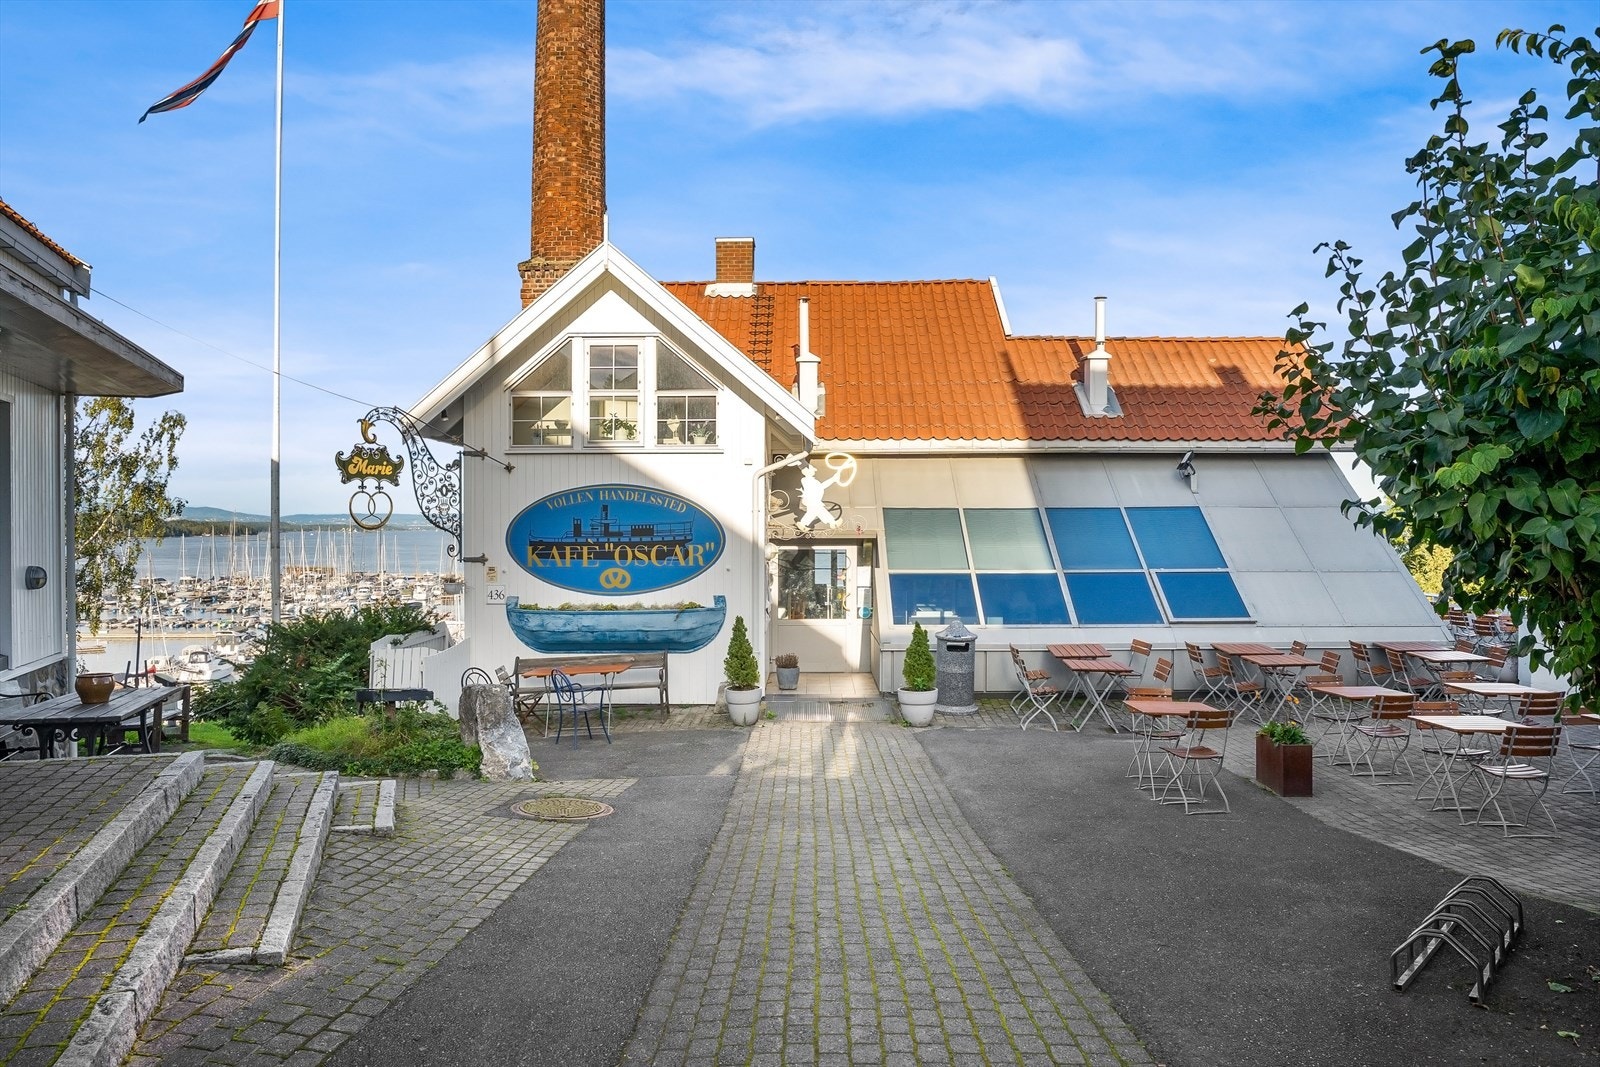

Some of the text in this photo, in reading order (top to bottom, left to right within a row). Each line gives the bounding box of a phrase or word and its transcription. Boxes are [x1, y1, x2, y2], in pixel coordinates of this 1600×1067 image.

[348, 456, 393, 475] Marie
[545, 490, 687, 513] VOLLEN HANDELSSTED
[604, 542, 715, 568] "OSCAR"
[487, 589, 506, 601] 436
